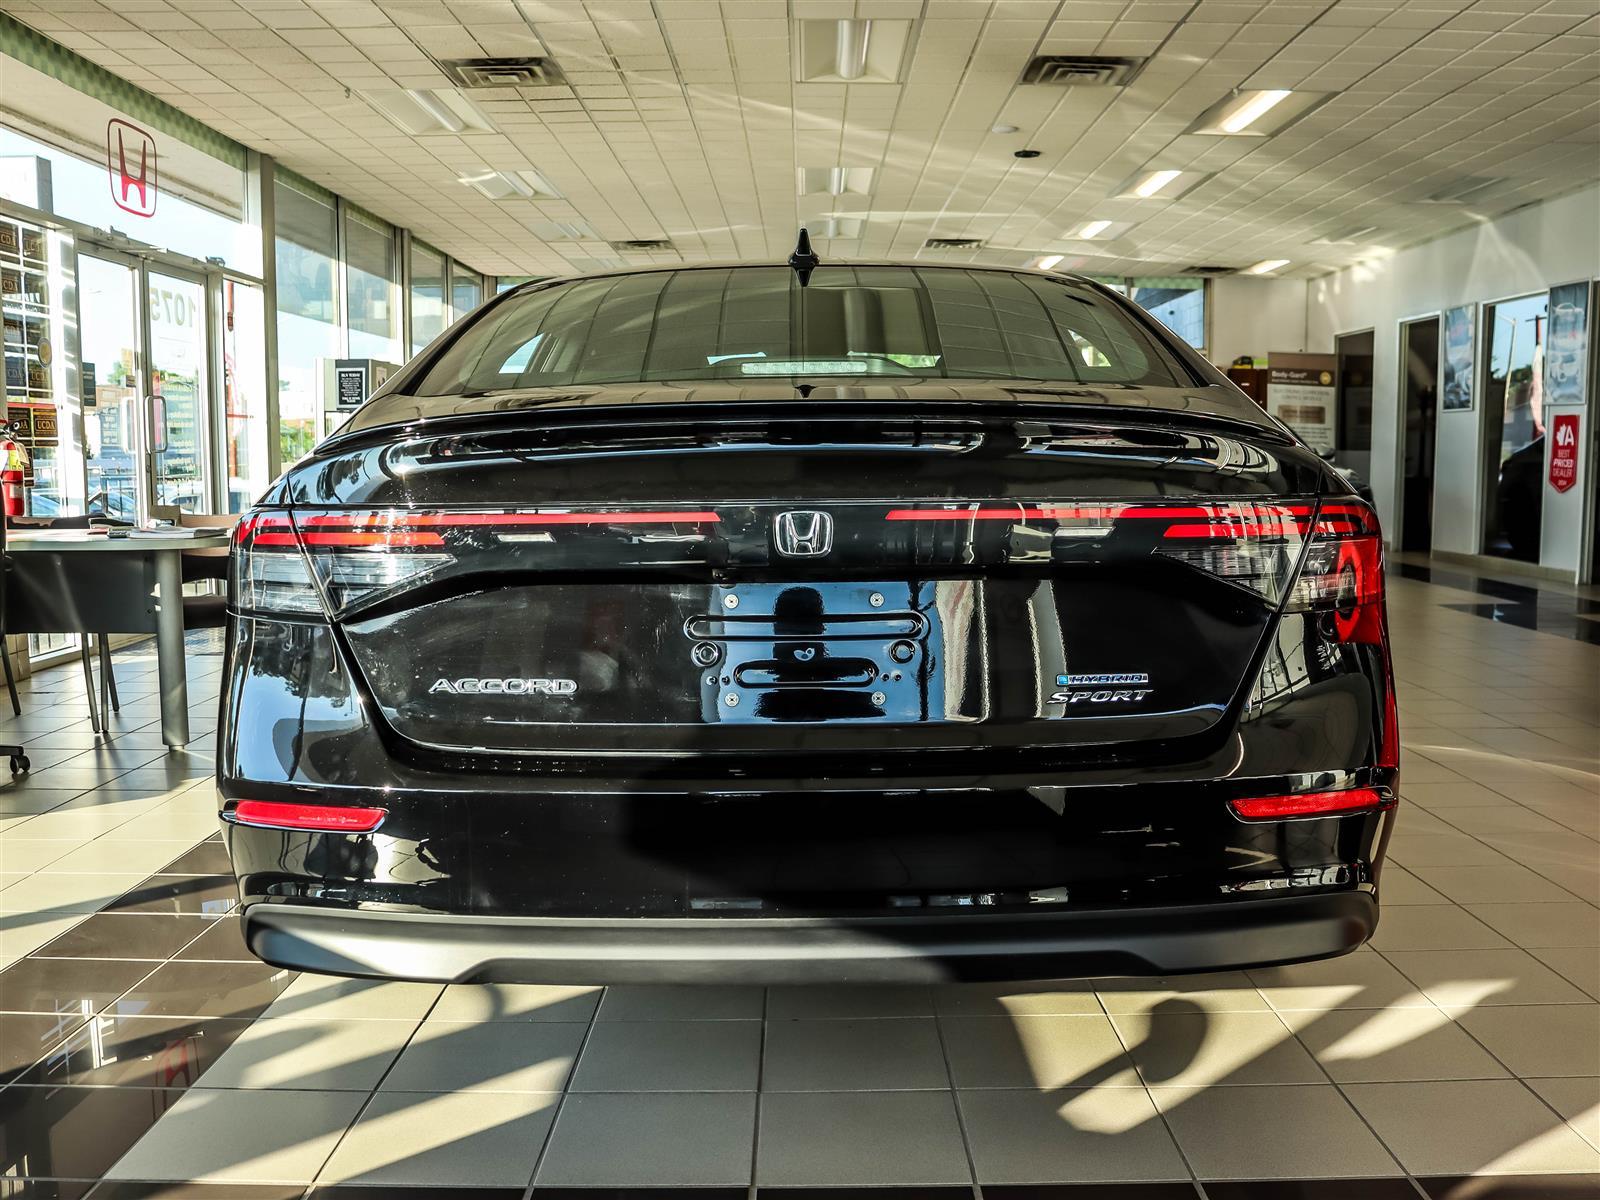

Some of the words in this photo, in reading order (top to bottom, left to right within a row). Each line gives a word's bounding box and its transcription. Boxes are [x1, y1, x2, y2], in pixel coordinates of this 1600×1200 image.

[37, 420, 55, 430] UCDA
[1557, 449, 1570, 458] BEST
[1553, 458, 1573, 468] PRICED
[1552, 468, 1573, 478] DEALER
[1070, 674, 1144, 684] HYBRID
[428, 678, 578, 694] ACCORD
[1046, 689, 1154, 704] SPORT
